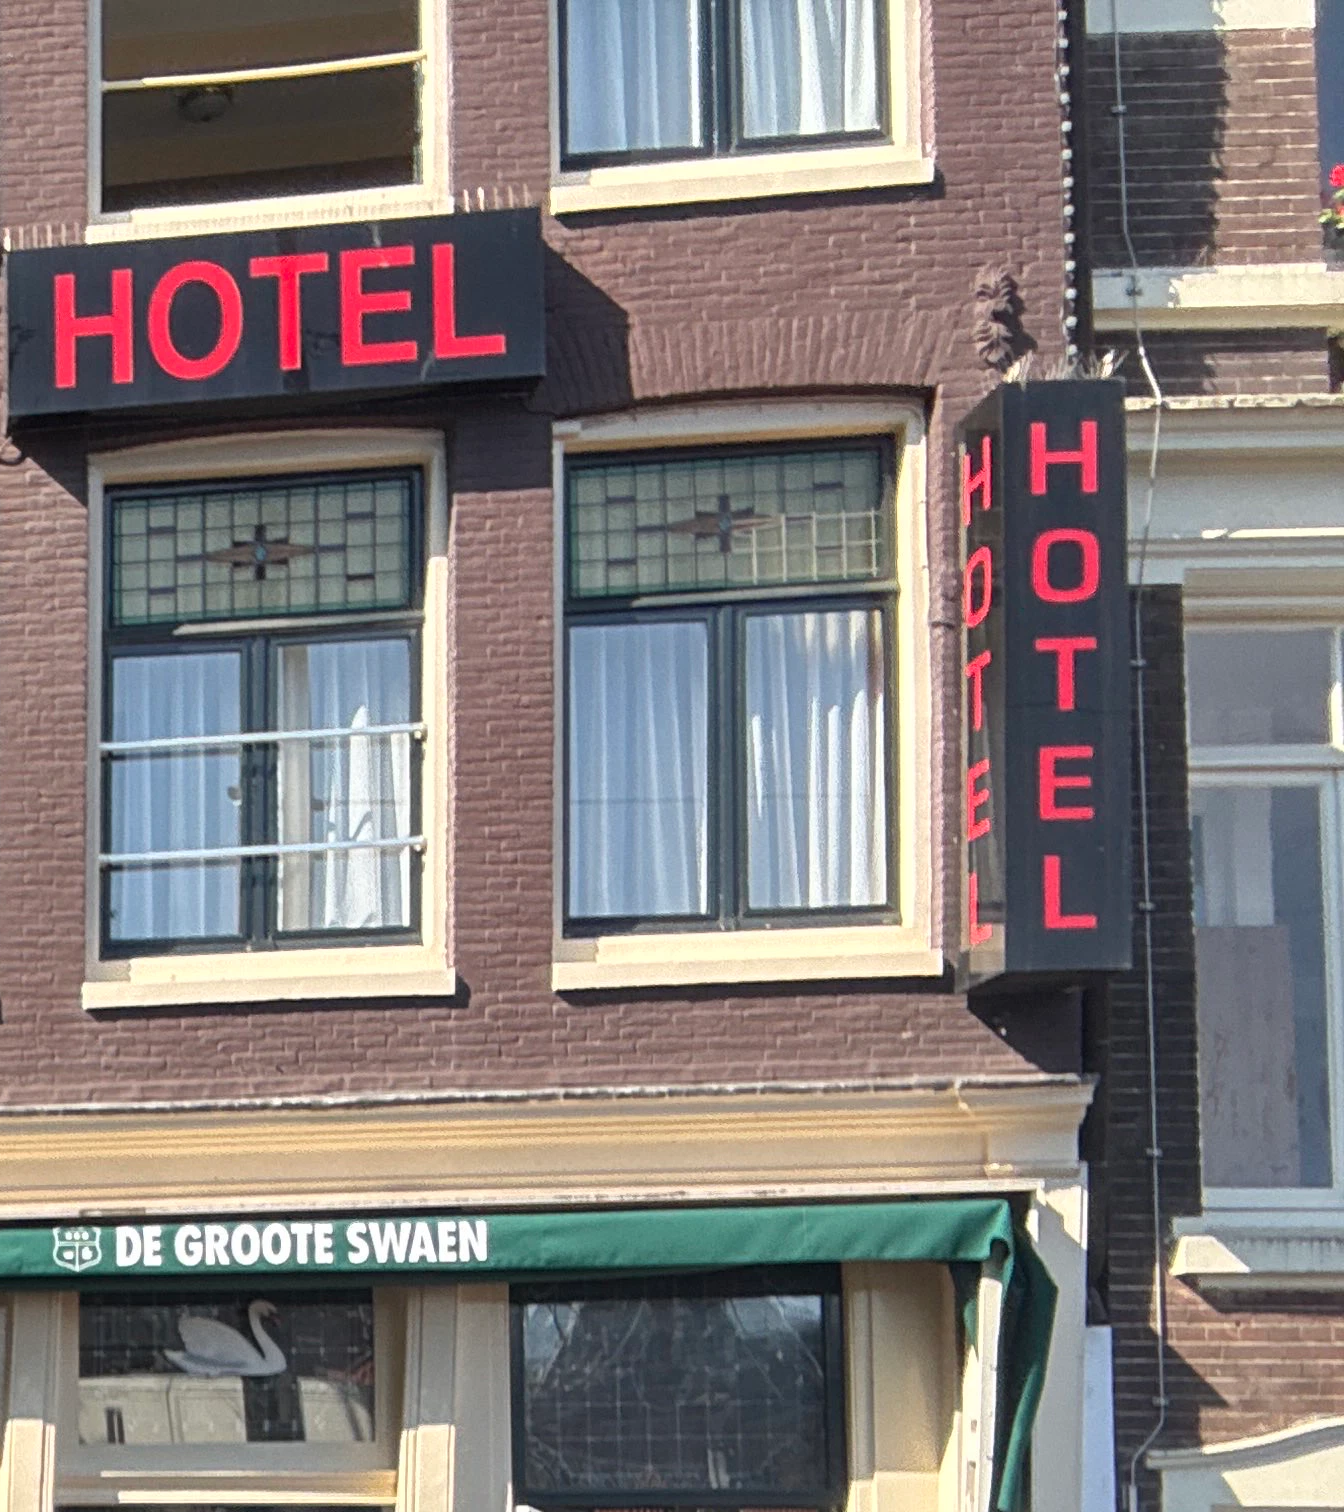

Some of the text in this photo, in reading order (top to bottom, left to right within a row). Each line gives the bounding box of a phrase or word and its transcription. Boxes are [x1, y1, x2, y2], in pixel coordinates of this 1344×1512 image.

[53, 243, 507, 389] HOTEL
[963, 435, 993, 945] HOTEL
[1028, 420, 1101, 930] HOTEL
[116, 1220, 488, 1267] DE GROOTE SWAEN
